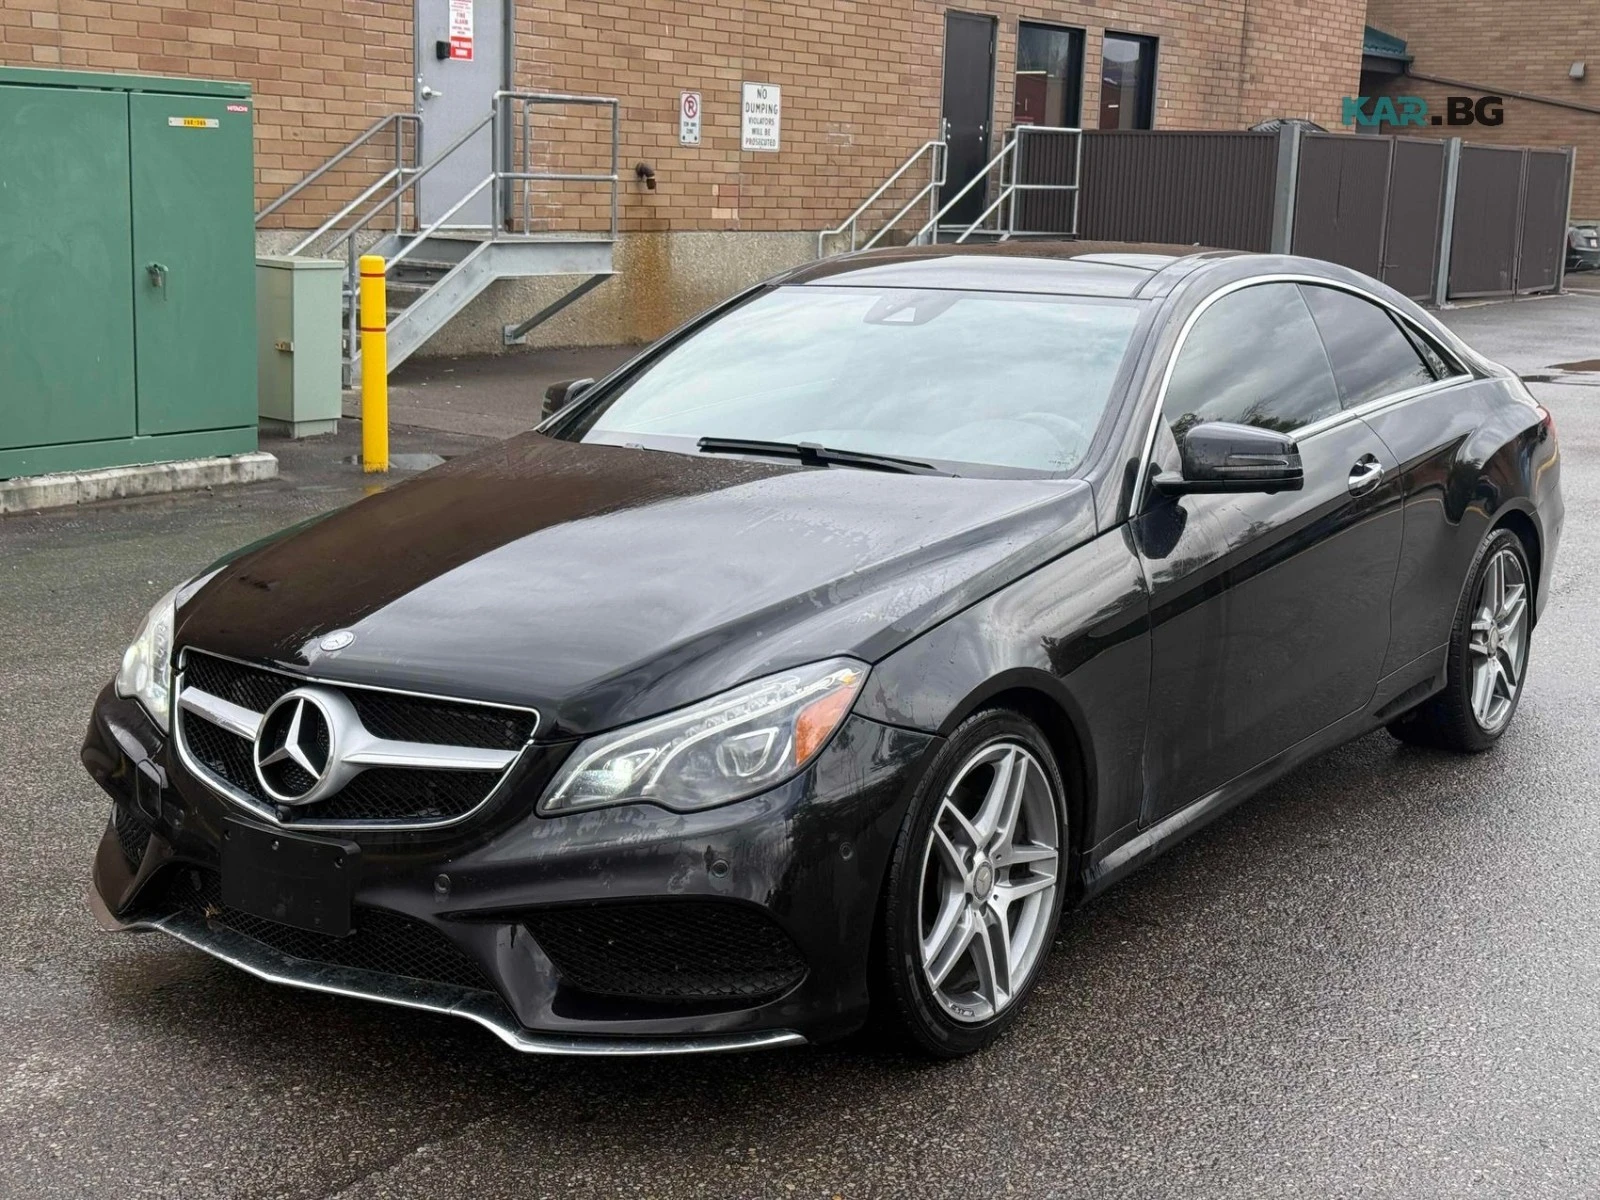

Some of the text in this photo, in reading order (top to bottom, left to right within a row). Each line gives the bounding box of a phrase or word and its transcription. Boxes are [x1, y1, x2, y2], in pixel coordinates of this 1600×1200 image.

[756, 88, 768, 100] NO
[745, 102, 779, 115] DUMPING
[748, 117, 775, 126] VIOLATORS
[751, 128, 771, 136] WILL BE
[745, 137, 777, 147] PROSECUTED
